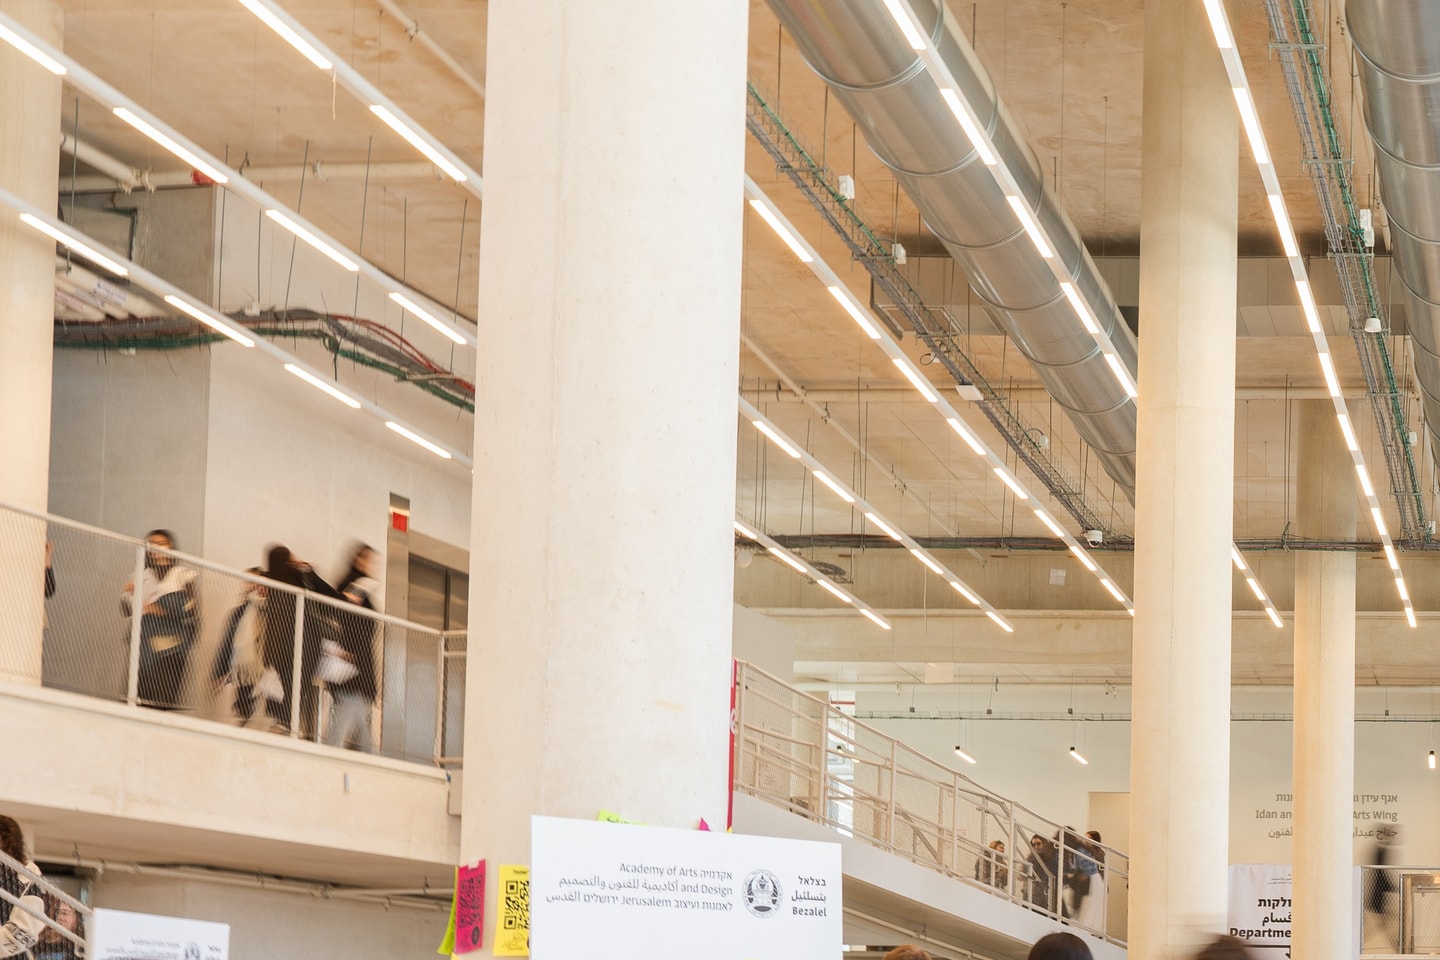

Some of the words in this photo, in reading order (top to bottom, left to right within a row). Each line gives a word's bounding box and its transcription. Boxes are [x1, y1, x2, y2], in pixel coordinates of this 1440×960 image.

[1255, 809, 1278, 819] Idan
[1280, 811, 1293, 819] an
[1372, 810, 1398, 822] Wing
[619, 863, 664, 877] Academy
[666, 866, 677, 876] of
[679, 867, 698, 877] Arts
[700, 870, 733, 882] אקדמיה
[798, 875, 827, 887] בצלאל
[681, 884, 699, 894] and
[701, 884, 733, 897] Design
[583, 892, 619, 904] ירושלים
[621, 896, 672, 909] Jerusalem
[674, 898, 700, 910] ועיצוב
[702, 901, 733, 912] לאמנות
[792, 906, 827, 917] Bezalel
[1229, 927, 1292, 941] Departme
